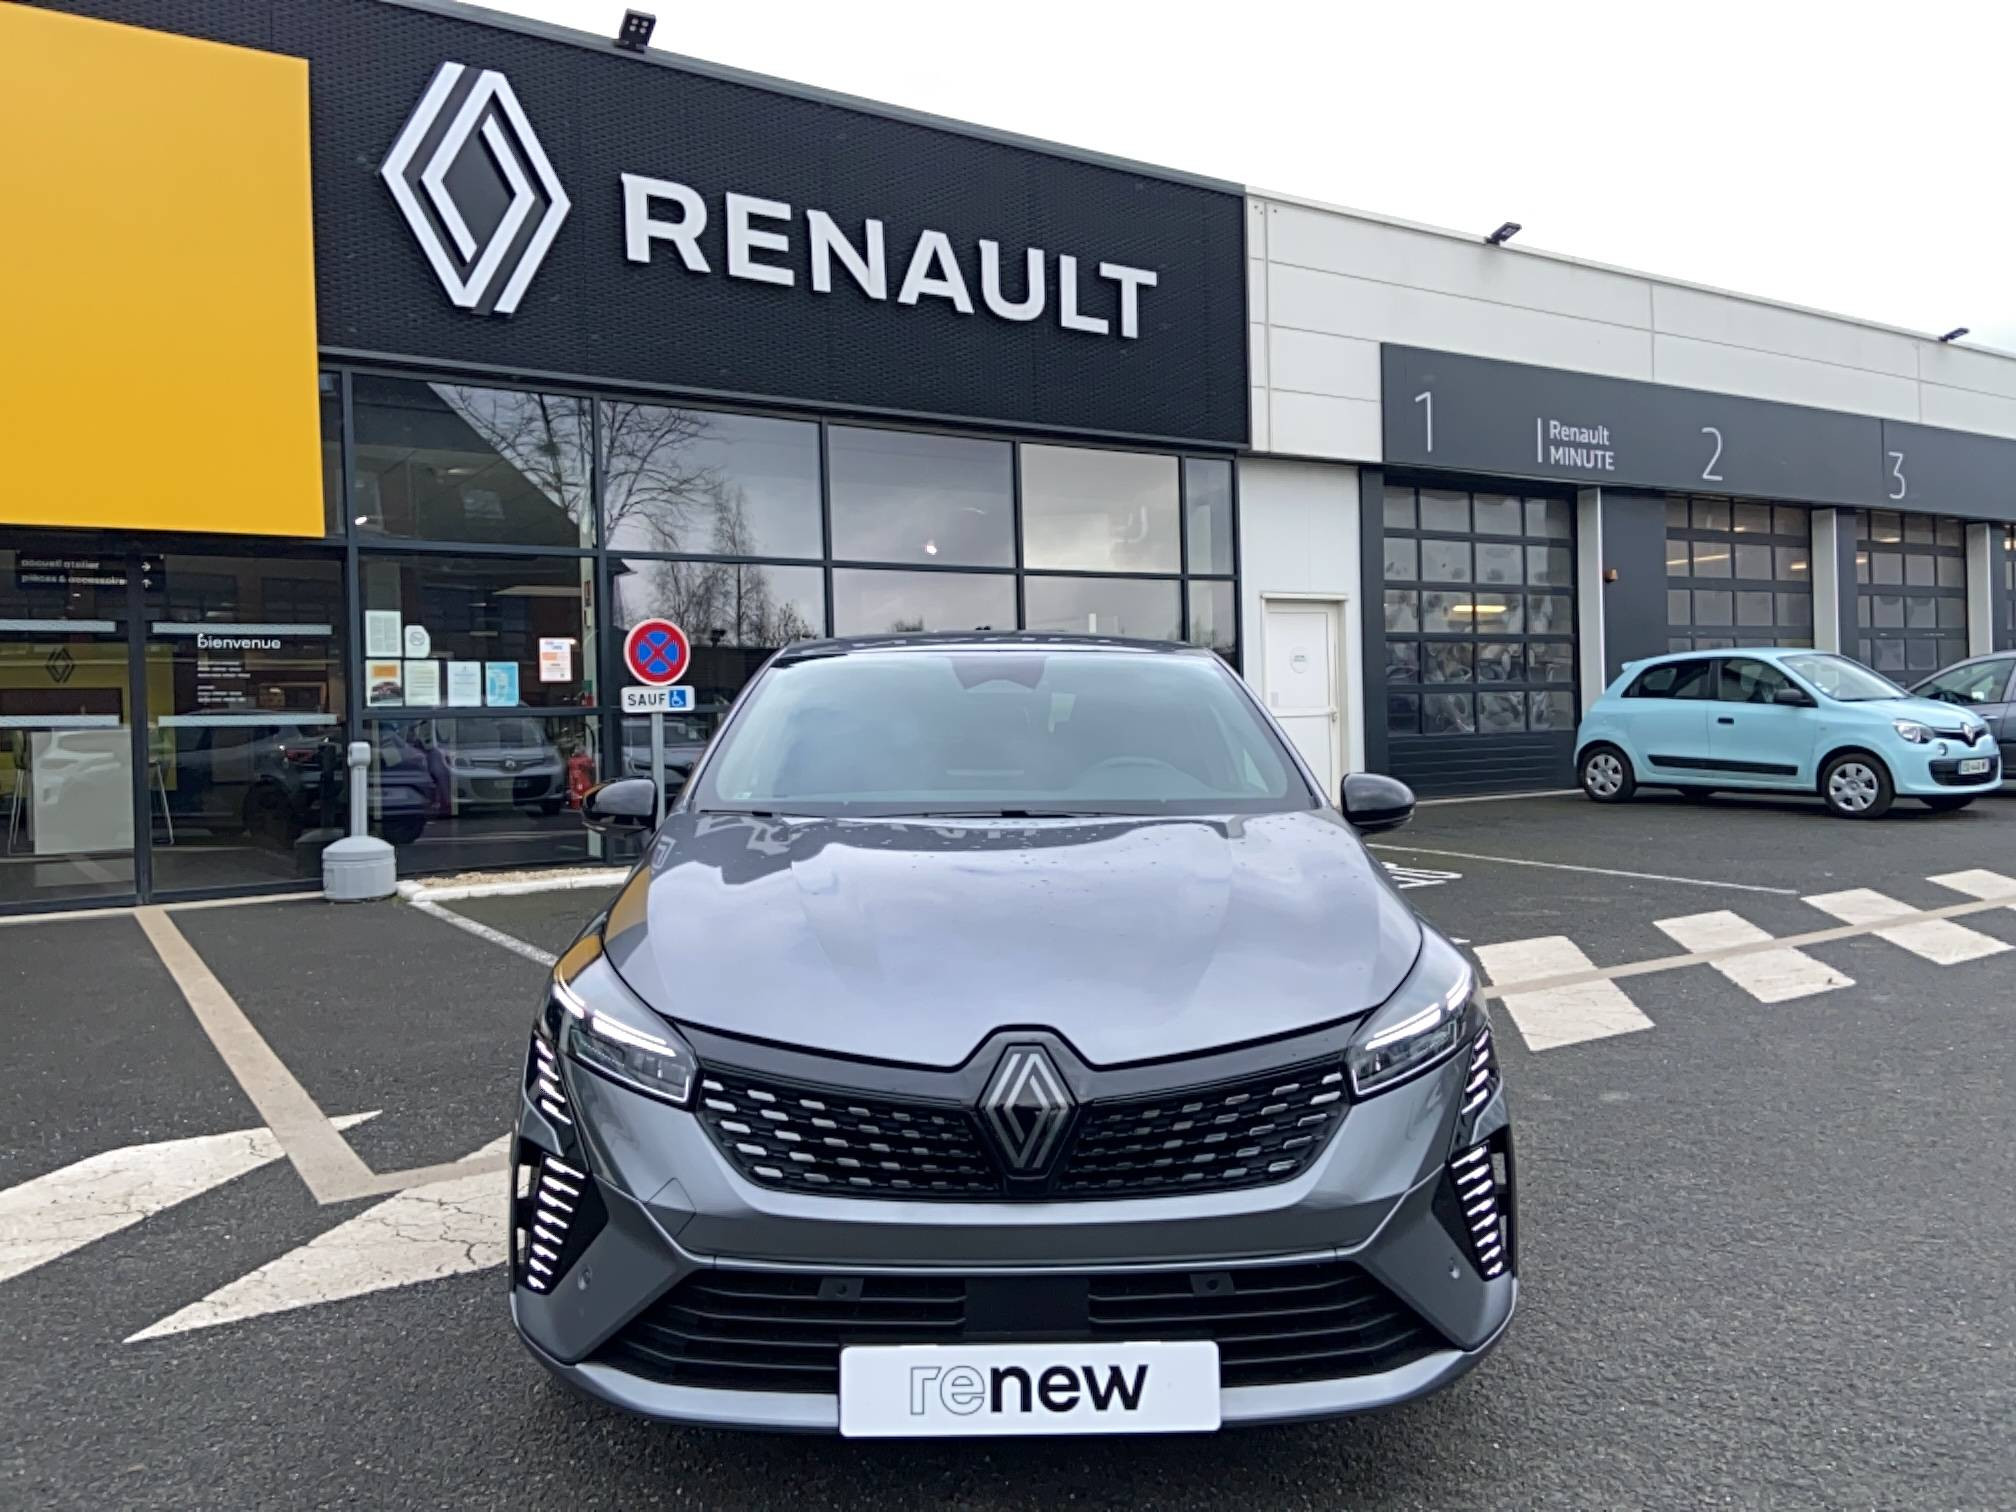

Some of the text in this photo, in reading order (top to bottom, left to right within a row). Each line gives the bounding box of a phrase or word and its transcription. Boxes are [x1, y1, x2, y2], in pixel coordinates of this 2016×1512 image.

[620, 172, 1158, 339] RENAULT
[1415, 391, 1432, 452] 1
[1549, 420, 1610, 446] Renault
[1549, 446, 1616, 471] MINUTE
[1701, 427, 1723, 481] 2
[1888, 451, 1906, 499] 3
[197, 633, 281, 649] bienvenue
[627, 693, 667, 706] SAUF
[910, 1364, 1149, 1416] renew
